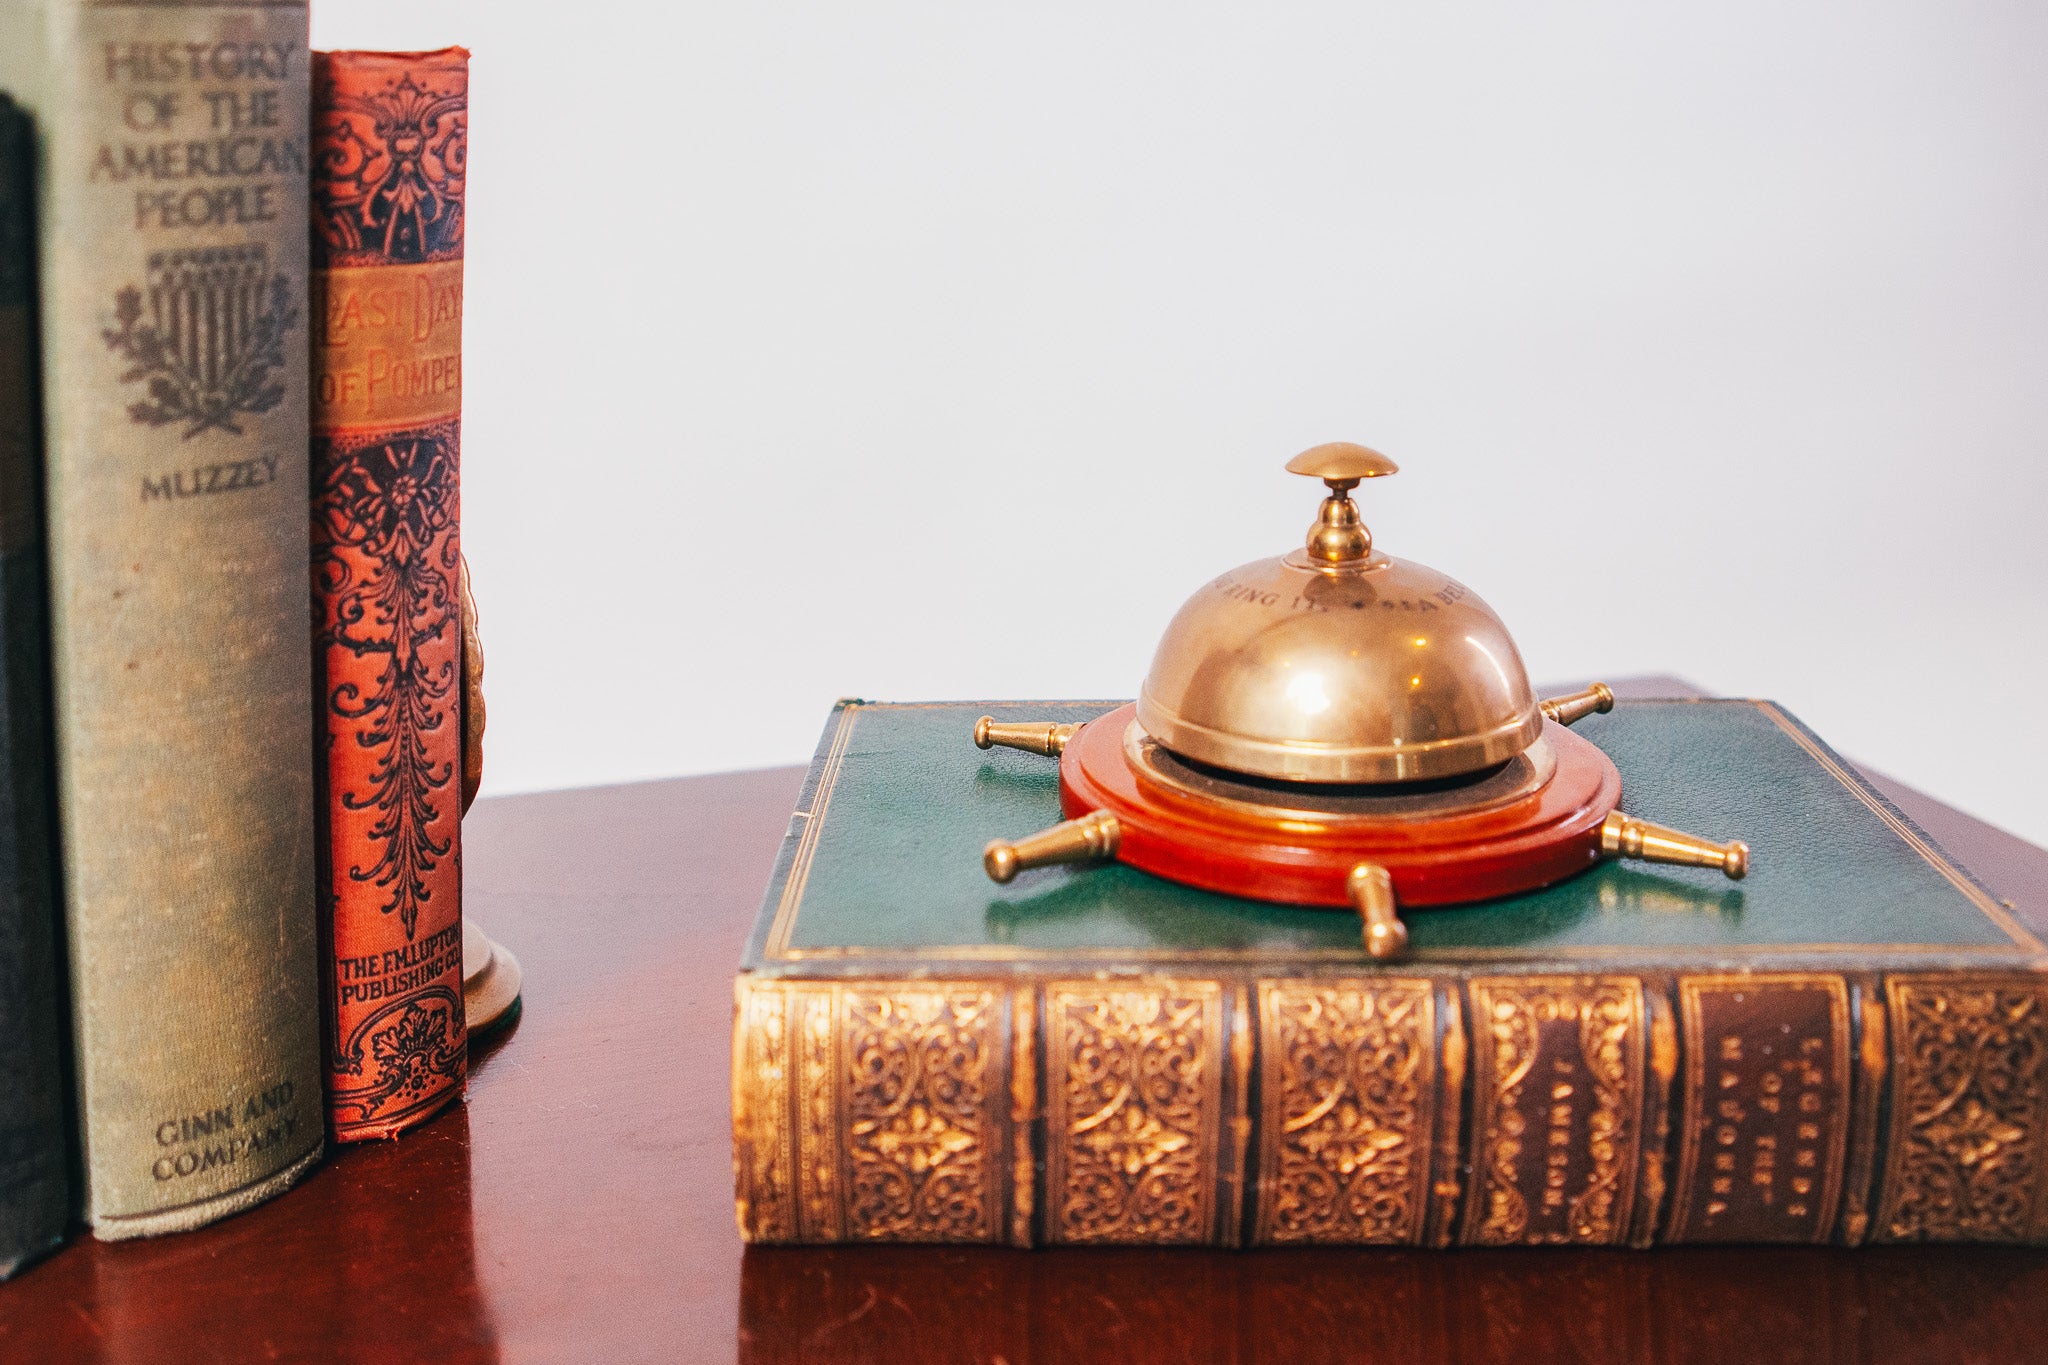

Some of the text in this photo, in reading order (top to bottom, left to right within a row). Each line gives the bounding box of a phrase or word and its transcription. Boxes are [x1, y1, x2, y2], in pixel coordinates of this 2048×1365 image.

[102, 41, 297, 83] HISTORY
[122, 89, 279, 133] OF THE
[90, 138, 303, 183] AMERICAN
[136, 185, 276, 230] PEOPLE
[317, 371, 361, 405] OF
[140, 456, 280, 503] MUZZEY
[339, 955, 380, 981] THE
[341, 956, 444, 1006] PUBLISHING
[155, 1080, 294, 1147] GINN AND
[152, 1116, 298, 1181] COMPANY
